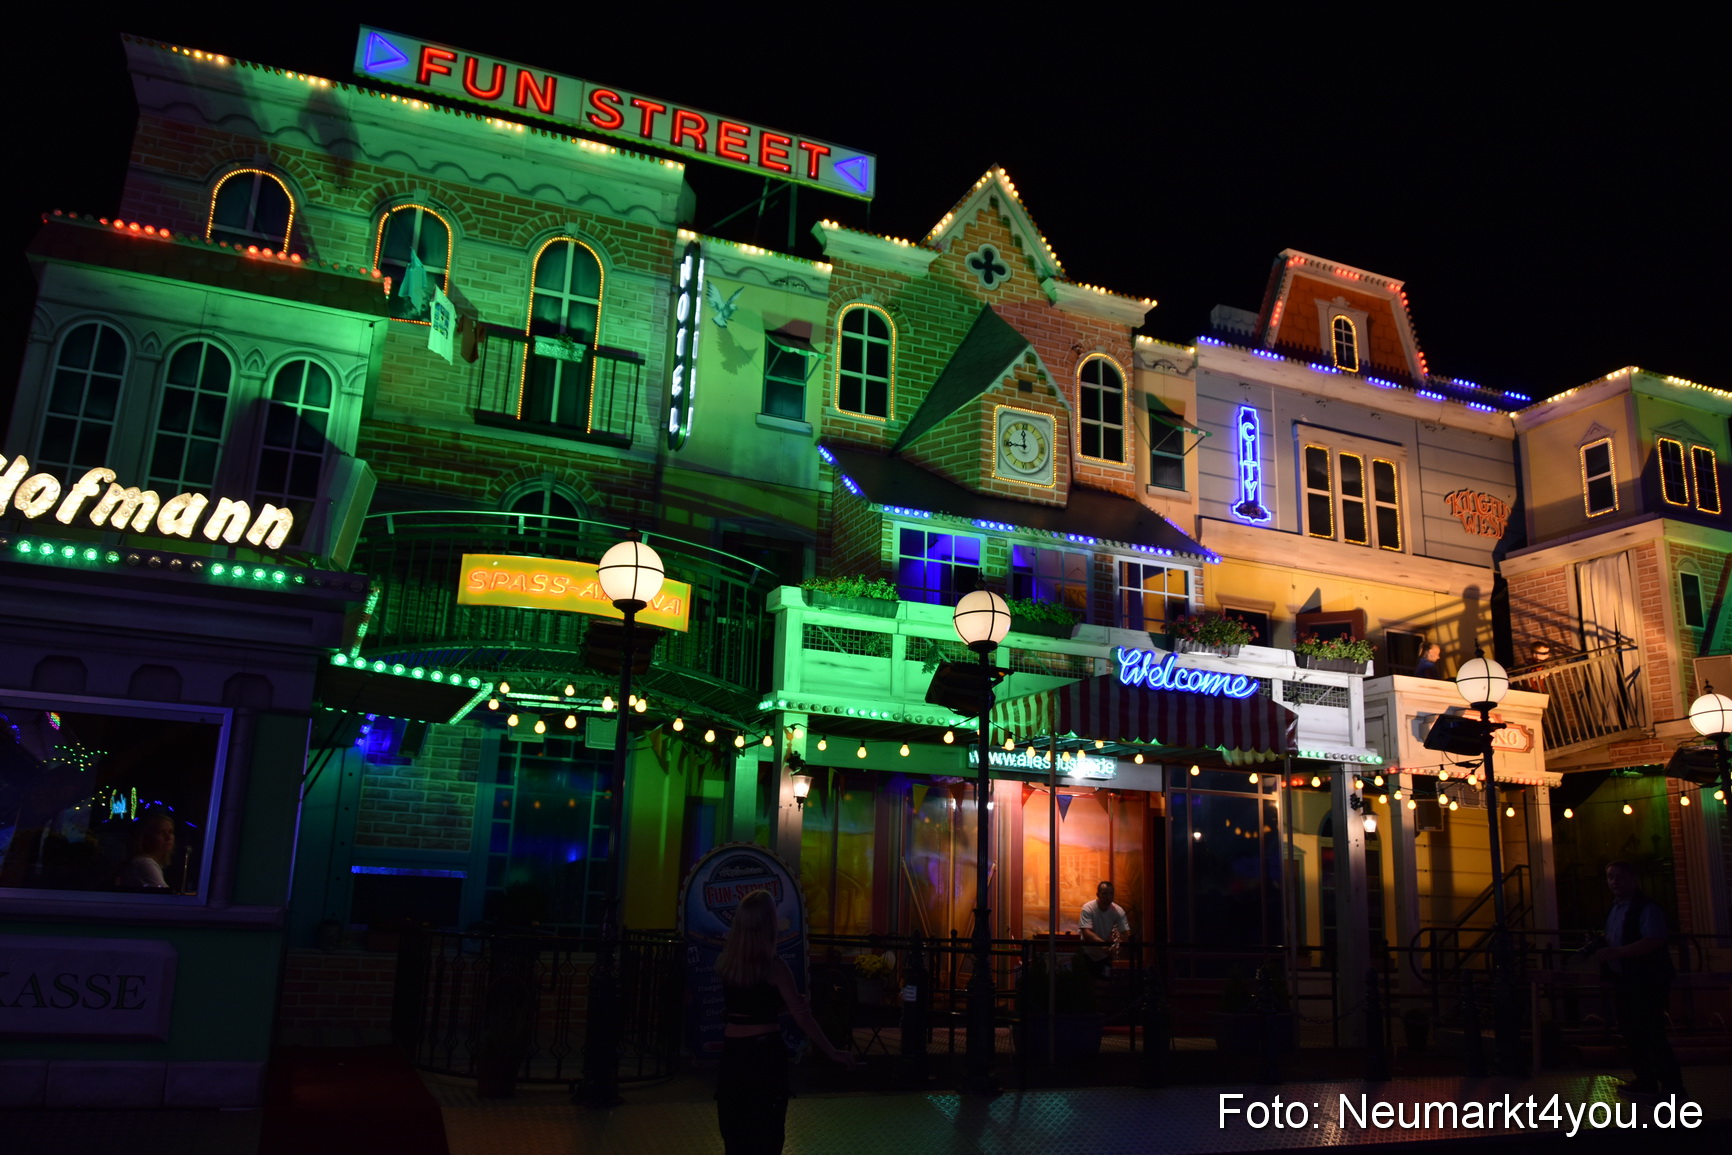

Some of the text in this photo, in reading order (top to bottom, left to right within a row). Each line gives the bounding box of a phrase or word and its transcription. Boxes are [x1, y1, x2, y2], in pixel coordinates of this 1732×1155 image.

[416, 45, 831, 180] FUN STREET
[1241, 421, 1259, 502] CITY
[466, 569, 682, 616] SPASS-ANA
[1112, 646, 1260, 699] Welcome
